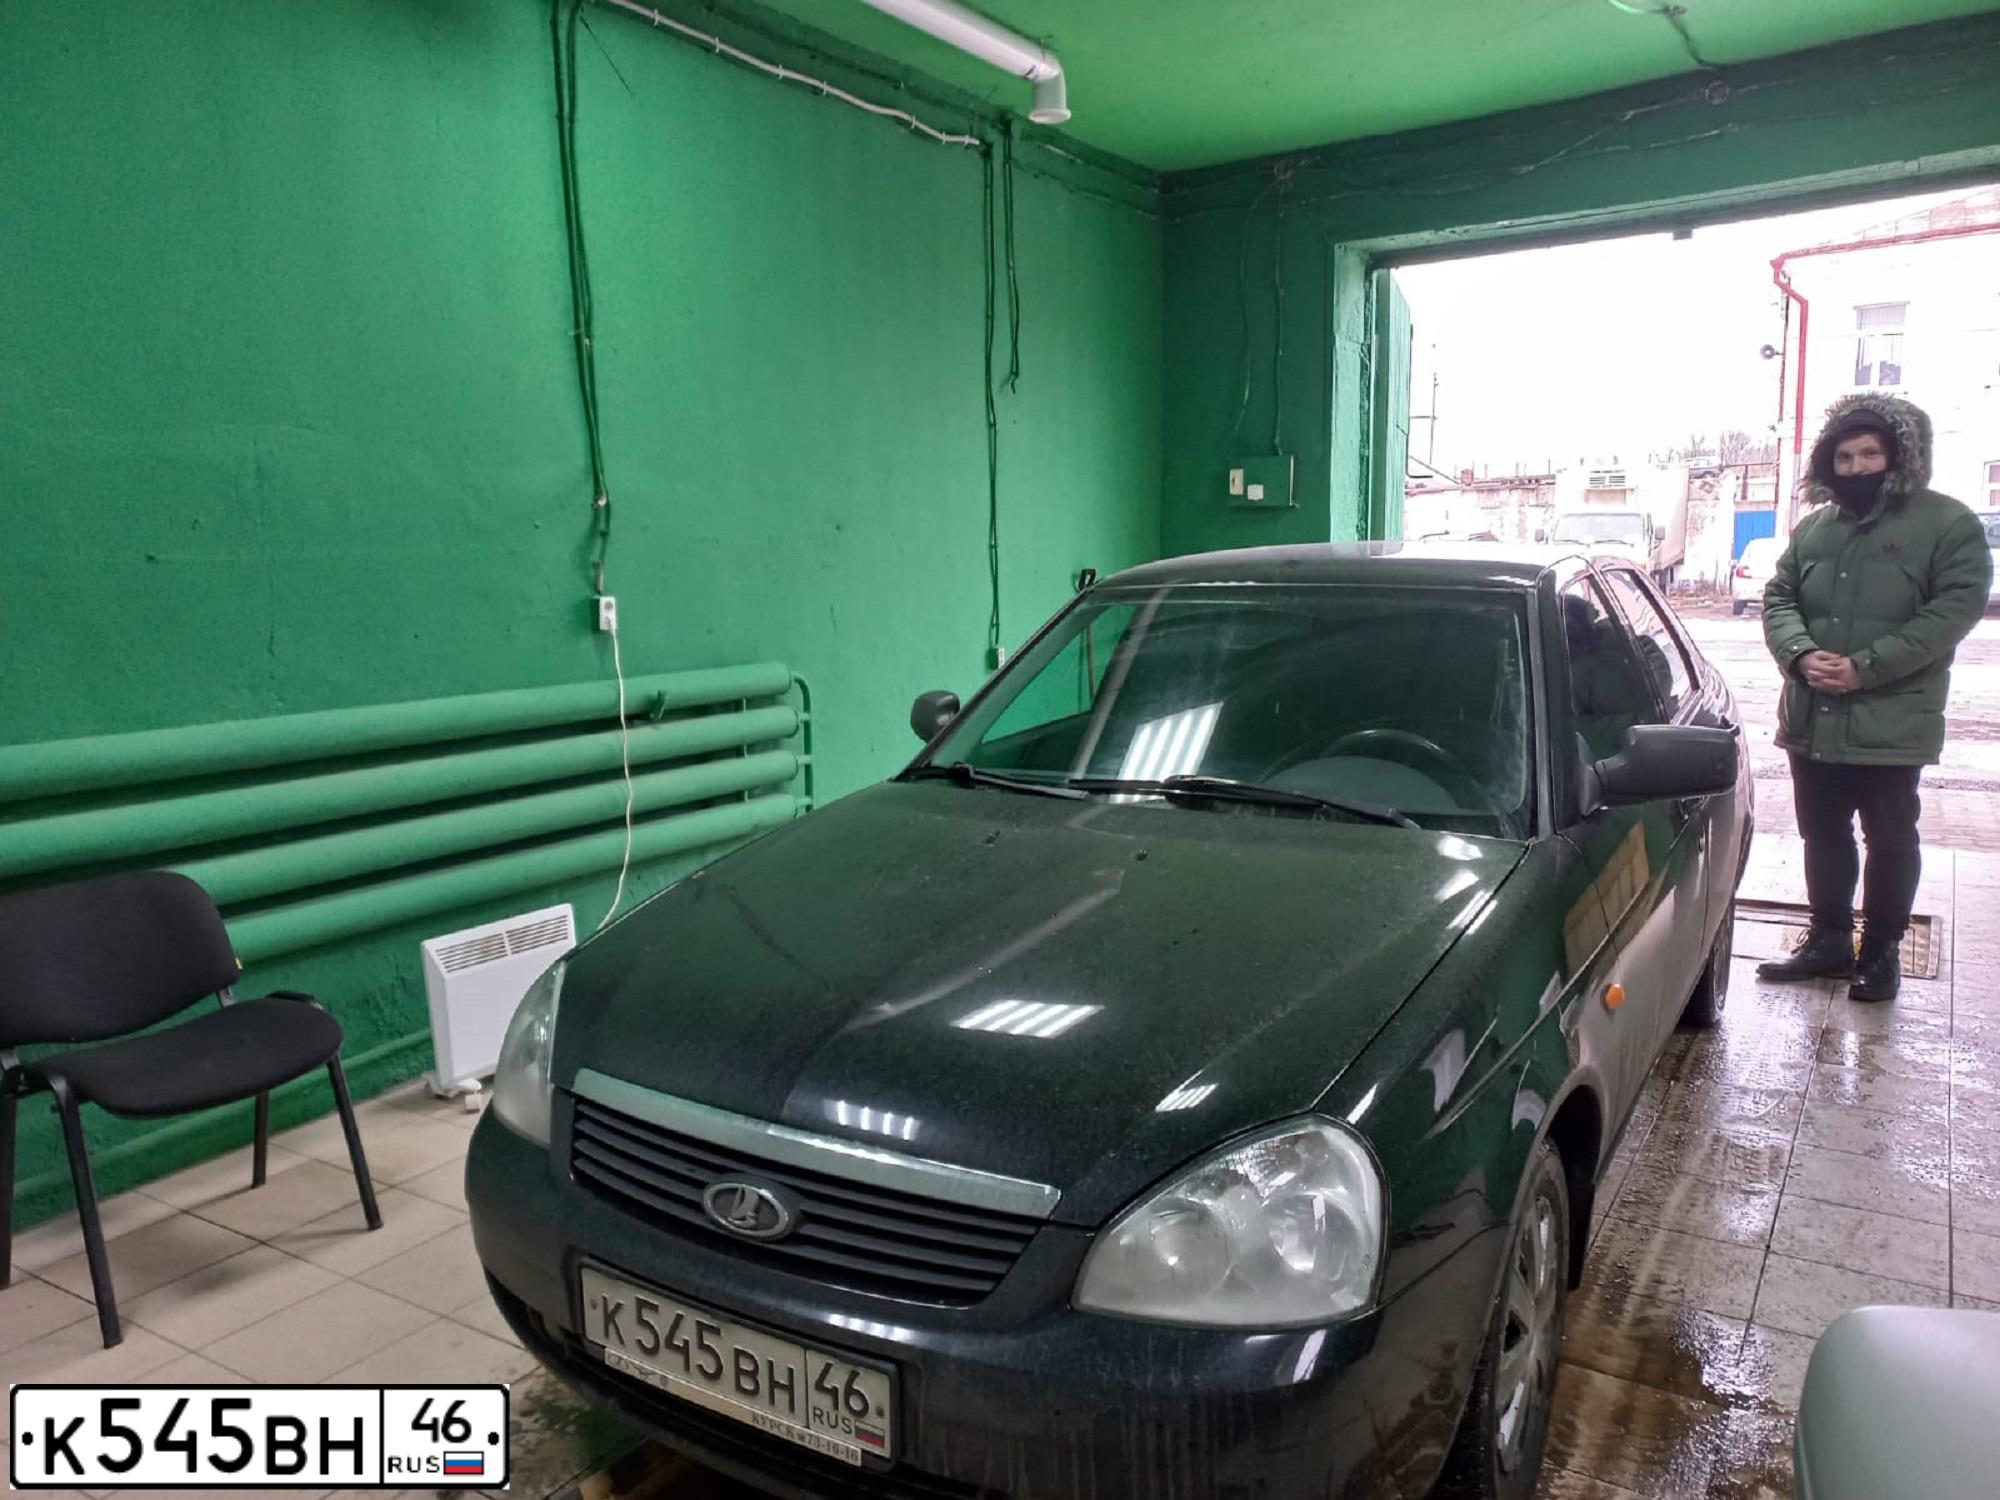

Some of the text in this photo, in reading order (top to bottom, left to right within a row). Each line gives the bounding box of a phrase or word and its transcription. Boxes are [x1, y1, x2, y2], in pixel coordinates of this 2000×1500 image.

[602, 1294, 796, 1415] К545ВН
[814, 1362, 870, 1418] 46
[813, 1407, 853, 1434] RUS
